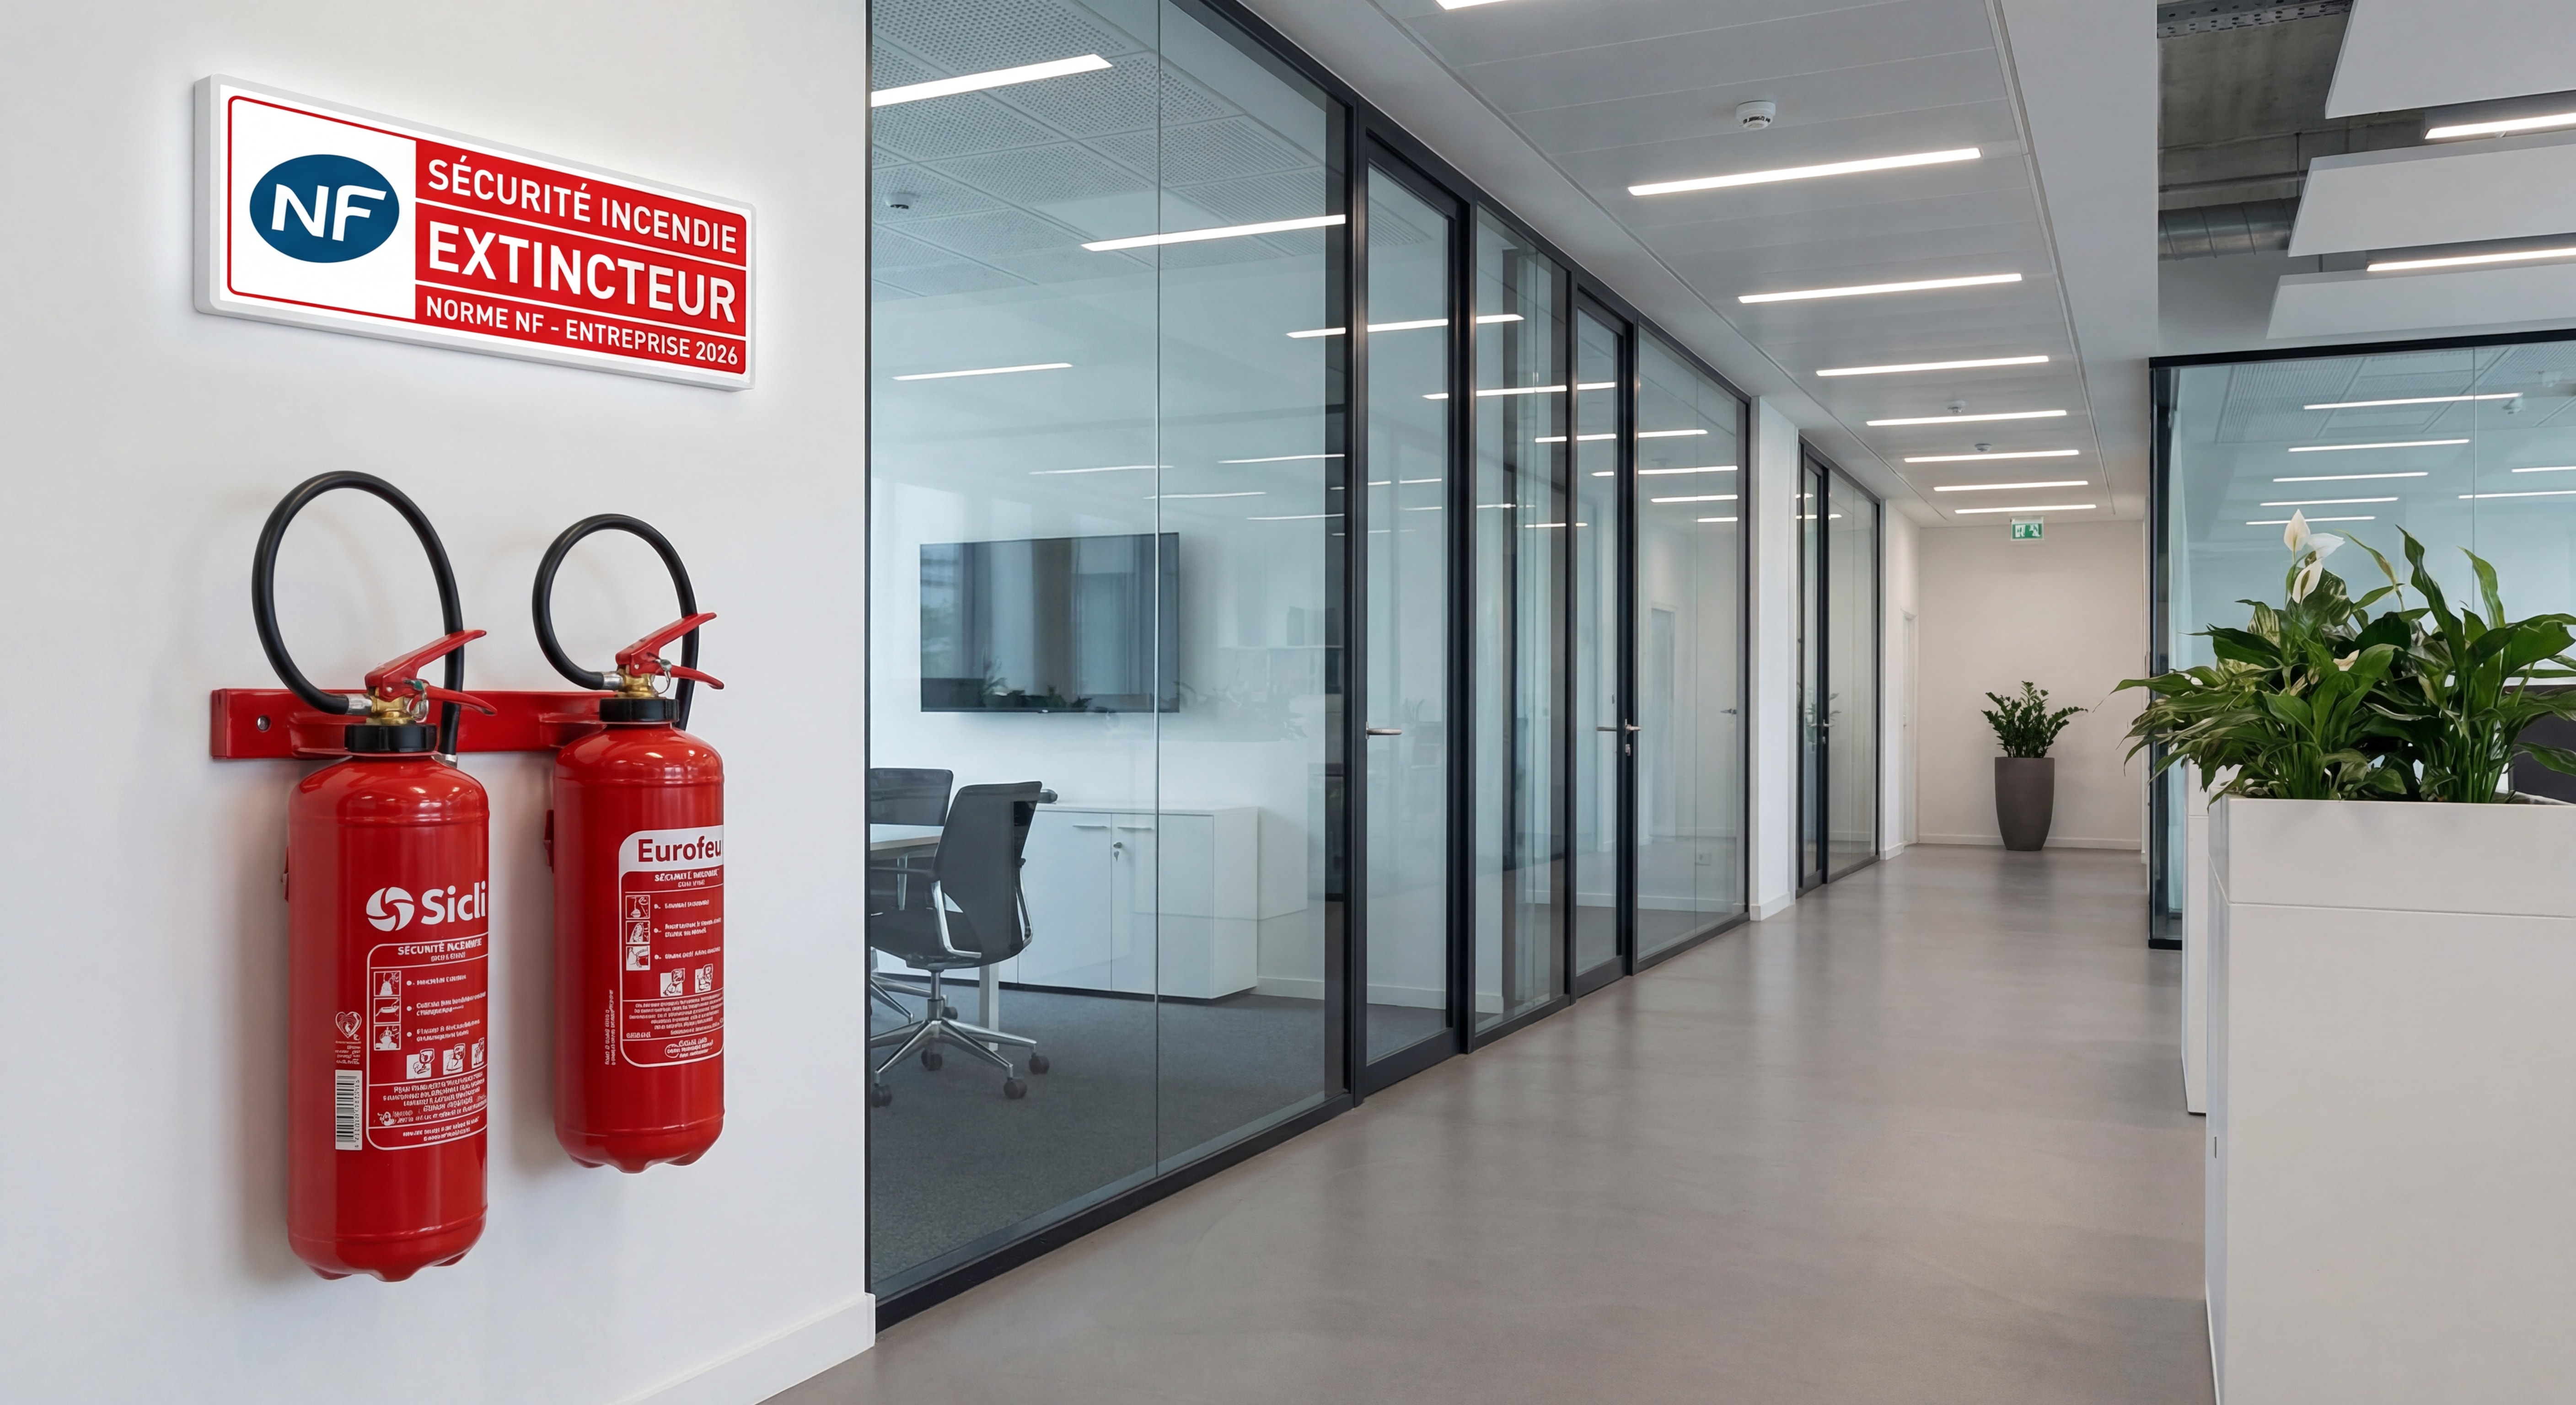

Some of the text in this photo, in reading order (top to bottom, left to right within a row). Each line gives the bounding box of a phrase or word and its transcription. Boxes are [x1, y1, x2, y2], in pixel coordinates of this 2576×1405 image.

[271, 183, 387, 242] NF
[428, 155, 736, 254] SÉCURITÉ INCENDIE
[429, 220, 735, 323] EXTINCTEUR
[427, 295, 508, 329] NORME
[516, 311, 544, 333] NF
[566, 319, 690, 358] ENTREPRISE
[696, 341, 738, 365] 2026
[638, 836, 721, 862] Eurofeu
[421, 880, 486, 925] Sicli
